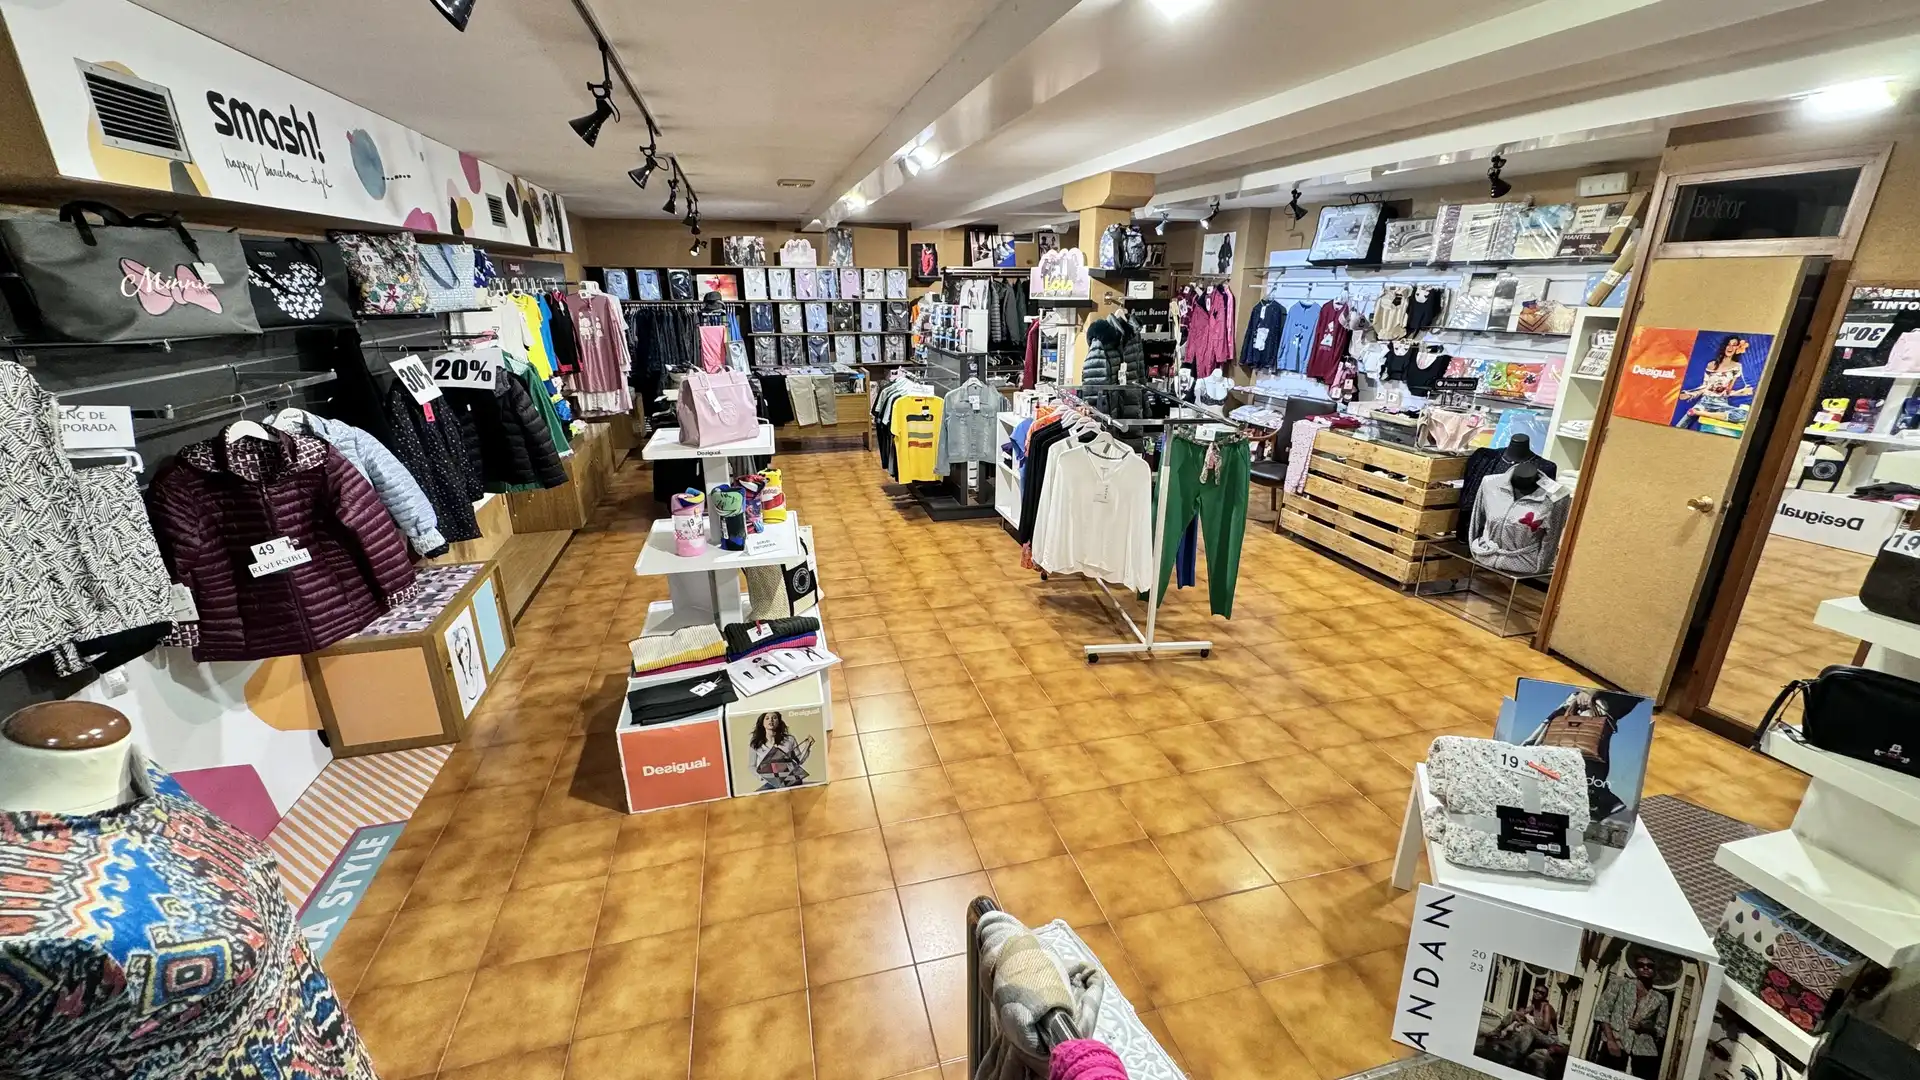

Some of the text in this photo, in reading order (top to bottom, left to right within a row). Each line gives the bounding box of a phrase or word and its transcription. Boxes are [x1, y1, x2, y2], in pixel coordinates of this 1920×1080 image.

[206, 90, 325, 164] smash!
[220, 142, 260, 191] happy
[260, 153, 308, 183] barcelona
[120, 266, 211, 297] Minnie
[1871, 300, 1920, 311] TINTO
[399, 363, 434, 394] 30%
[433, 358, 492, 382] 20%
[89, 411, 107, 420] DE
[258, 543, 275, 556] 49
[251, 552, 309, 574] REVERSIBLE
[642, 756, 711, 777] Desigual.
[1500, 753, 1519, 769] 19
[317, 835, 390, 909] STYLE
[1471, 949, 1487, 960] 20
[1402, 894, 1456, 1051] ANDAM
[1469, 961, 1484, 973] 23
